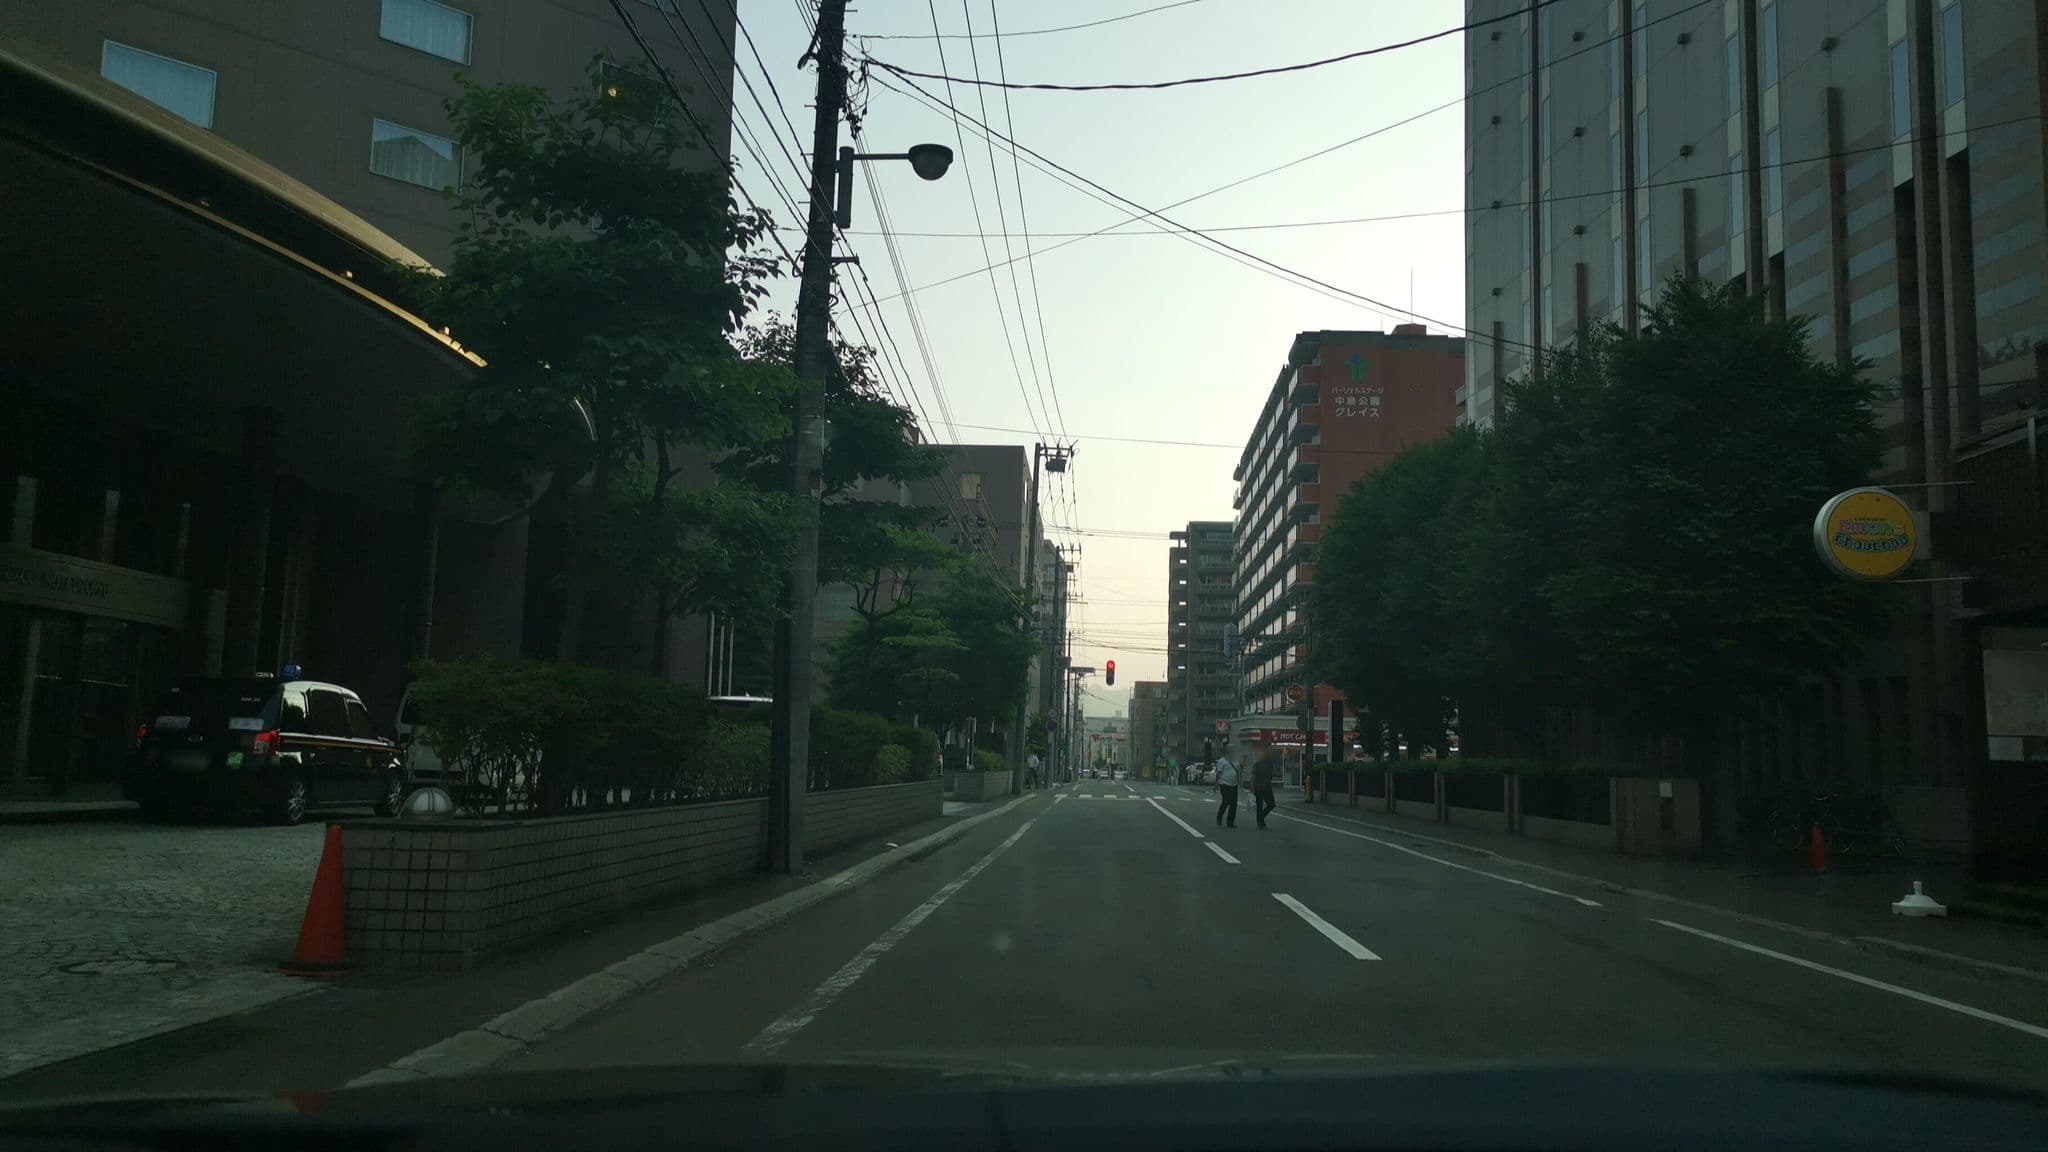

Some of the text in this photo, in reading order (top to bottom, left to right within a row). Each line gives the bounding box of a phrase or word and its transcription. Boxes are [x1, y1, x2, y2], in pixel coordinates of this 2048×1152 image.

[1335, 396, 1380, 406] 中島公園
[1335, 407, 1380, 417] グレイス
